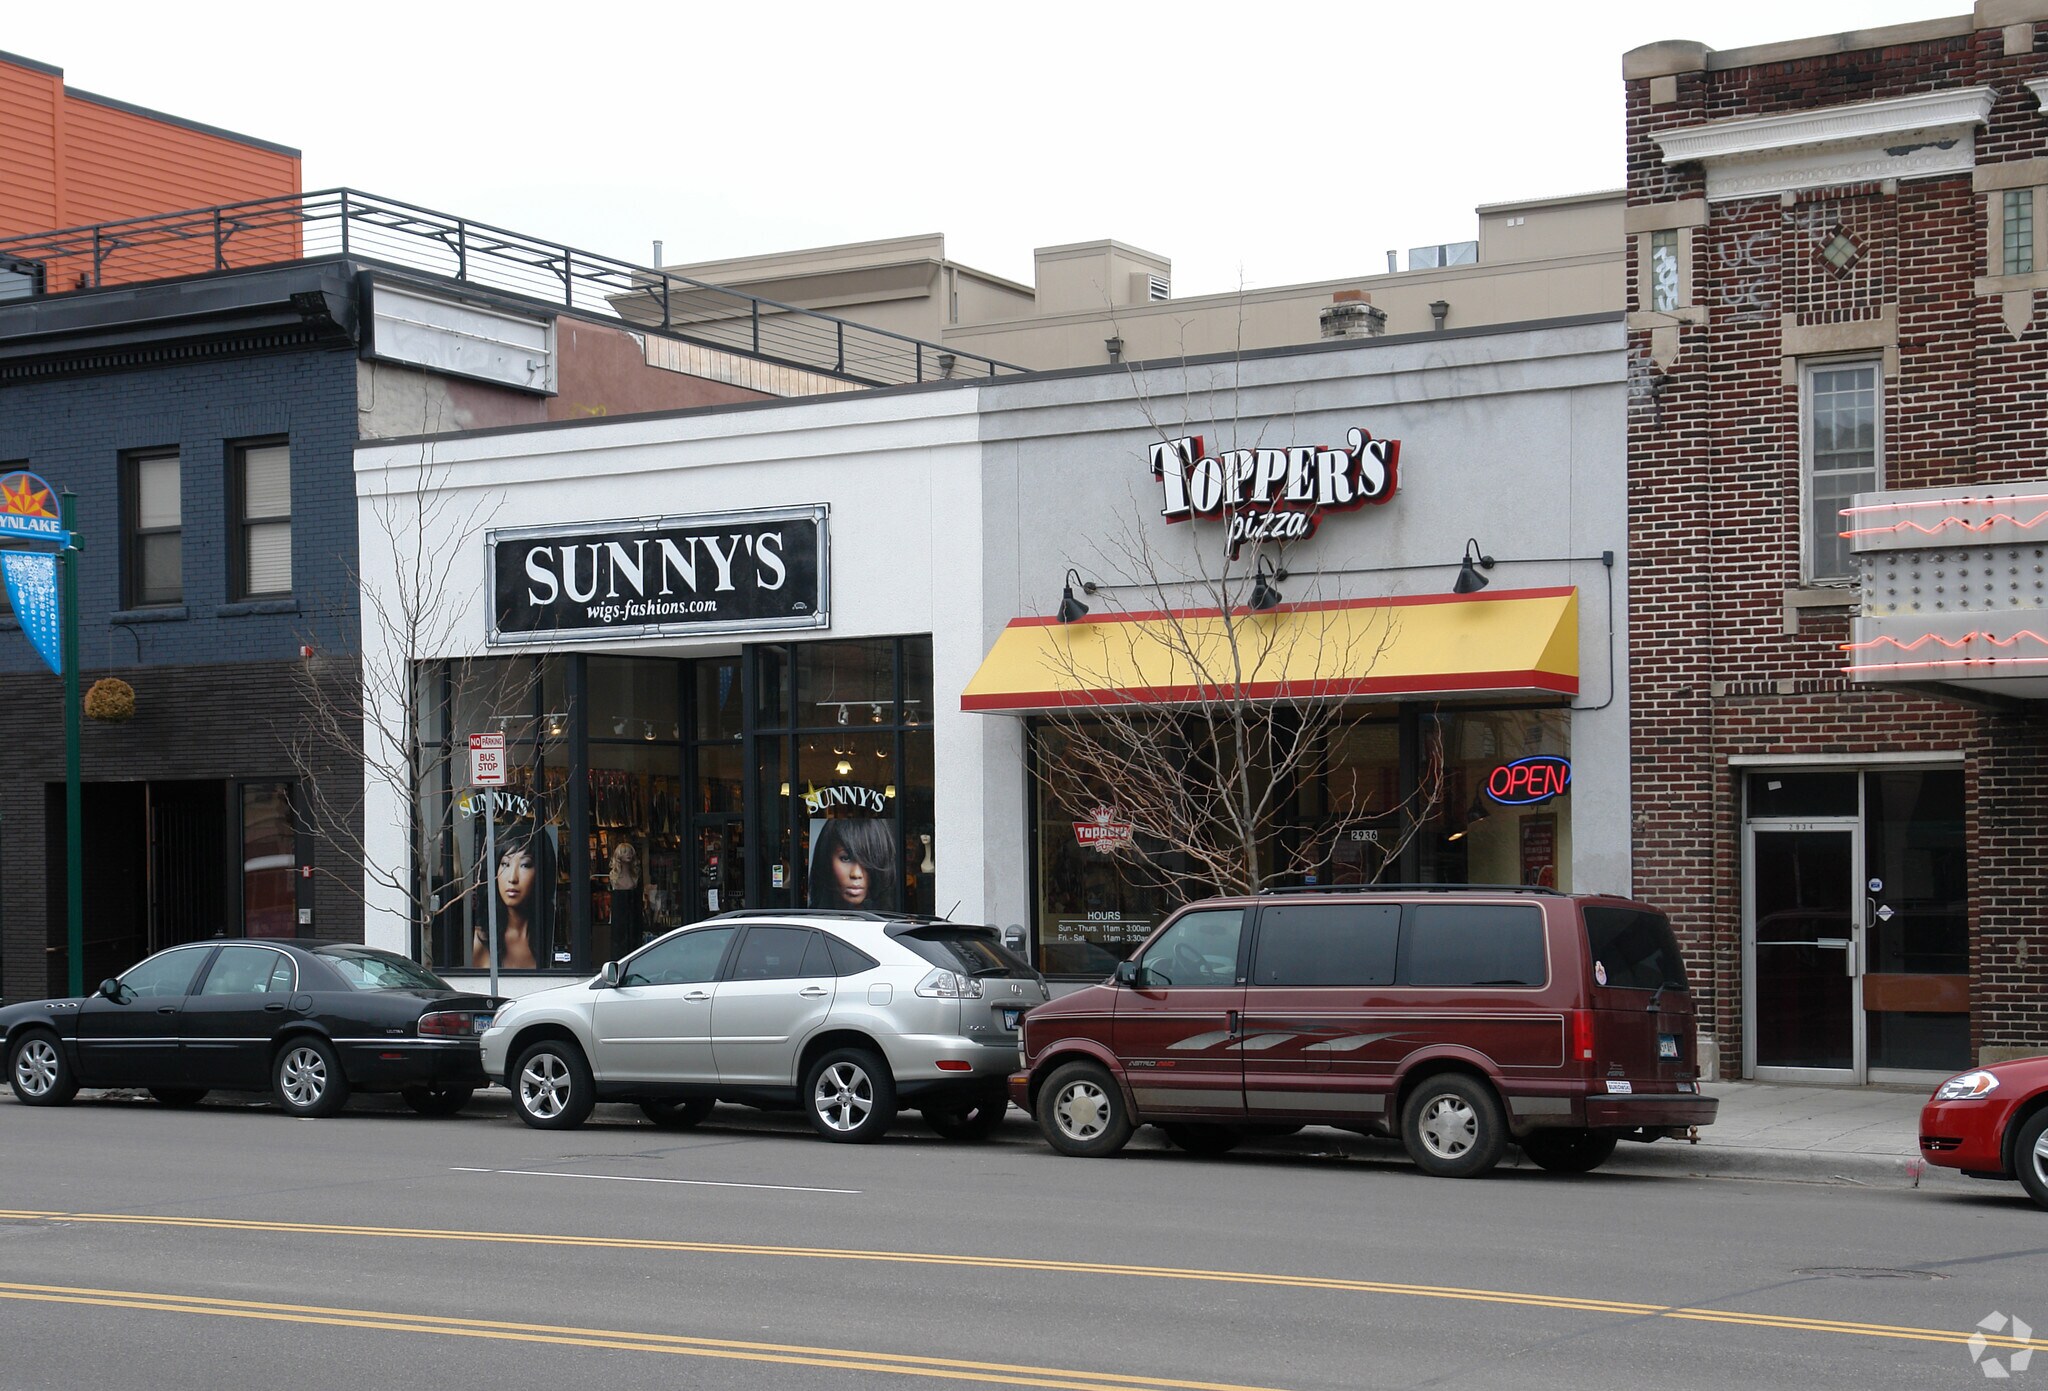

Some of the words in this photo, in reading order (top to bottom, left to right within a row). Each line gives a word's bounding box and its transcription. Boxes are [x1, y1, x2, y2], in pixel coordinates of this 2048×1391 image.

[1149, 427, 1393, 516] TOPPER'S
[1225, 510, 1308, 559] pizza
[525, 531, 786, 606] SUNNY'S
[586, 598, 718, 623] wigs-fashions.com
[470, 737, 481, 746] NO
[482, 736, 503, 746] PARKING
[479, 753, 496, 762] BUS
[478, 762, 498, 771] STOP
[1489, 765, 1567, 796] OPEN
[805, 785, 886, 815] SUNNY'S
[1352, 830, 1377, 840] 2936
[1087, 911, 1121, 920] HOURS
[1078, 924, 1098, 932] Thurs.
